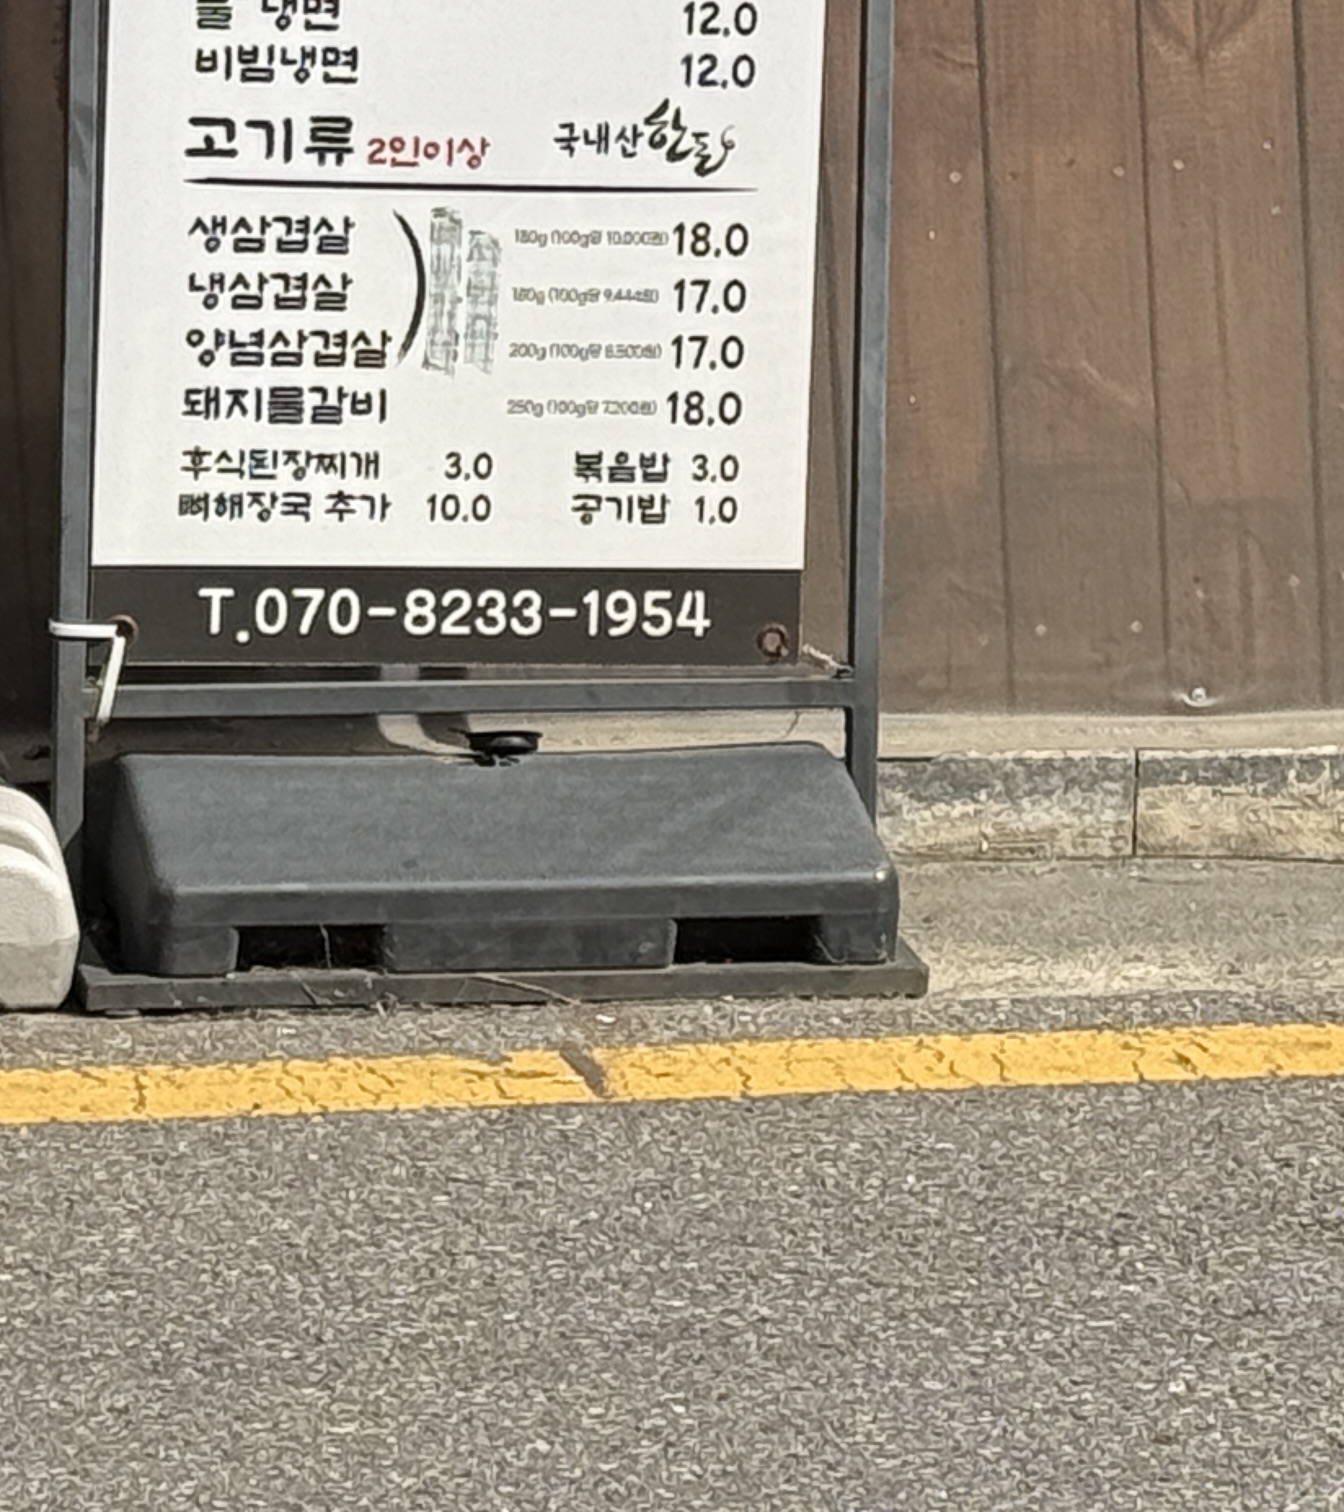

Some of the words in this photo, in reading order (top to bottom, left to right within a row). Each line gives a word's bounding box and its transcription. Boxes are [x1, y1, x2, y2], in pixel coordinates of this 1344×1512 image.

[683, 1, 758, 38] 12.0
[195, 44, 359, 85] 비빔냉면
[680, 53, 756, 90] 12.0
[184, 115, 355, 167] 고기류
[367, 135, 491, 170] 2인이상
[553, 121, 643, 159] 국내산
[187, 215, 356, 256] 생삼겹살
[672, 221, 749, 258] 18.0
[188, 271, 354, 312] 냉삼겹살
[673, 278, 747, 315] 17.0
[185, 328, 393, 369] 양념삼겹살
[671, 334, 744, 371] 17.0
[666, 390, 742, 427] 18.0
[444, 451, 493, 481] 3.0
[691, 453, 740, 483] 3.0
[324, 489, 392, 523] 추가
[426, 493, 492, 523] 10.0
[571, 492, 671, 526] 공기밥
[695, 495, 738, 525] 1.0
[199, 588, 710, 642] T.070-8233-1954
